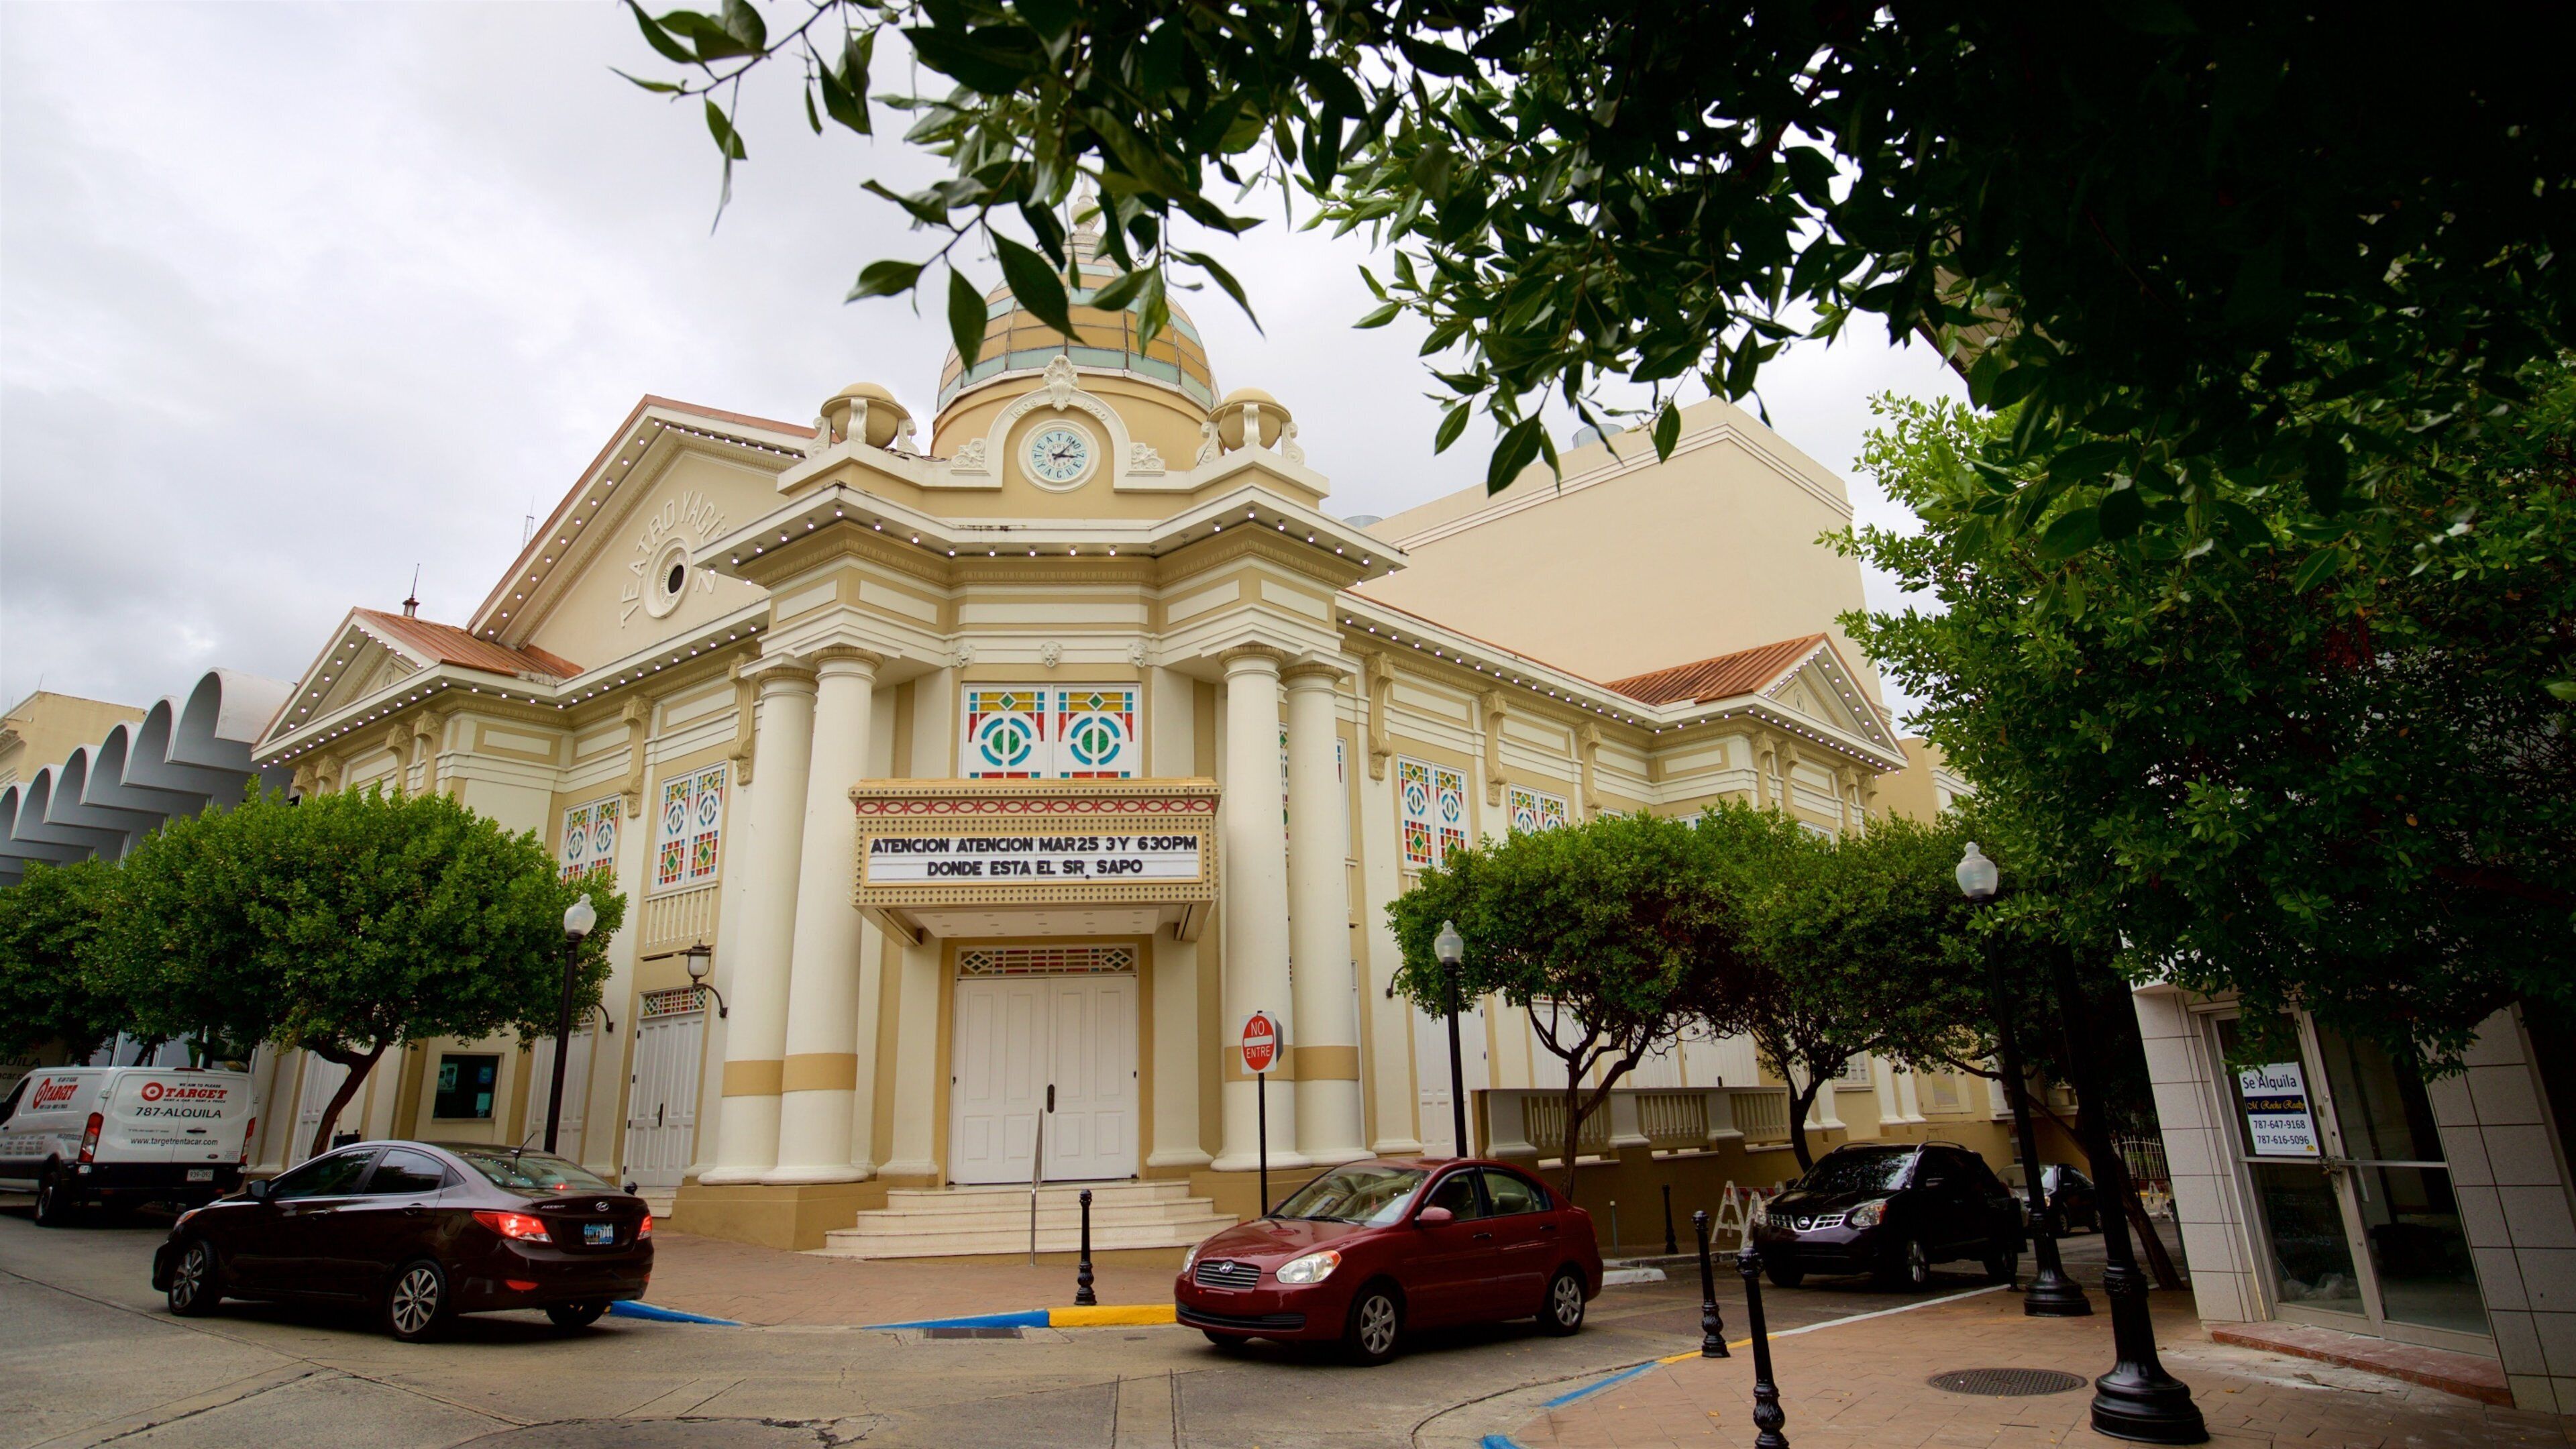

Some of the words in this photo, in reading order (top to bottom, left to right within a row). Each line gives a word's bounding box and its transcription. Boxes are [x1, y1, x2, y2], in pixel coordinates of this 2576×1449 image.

[620, 498, 676, 629] TEATRO
[871, 838, 949, 853] ATENCION
[956, 837, 1033, 853] ATENCION
[927, 861, 983, 875] DONDE
[990, 861, 1032, 875] ESTA
[1036, 860, 1056, 875] EL
[1097, 859, 1143, 873] SAPO
[1250, 1020, 1265, 1036] NO
[1246, 1046, 1271, 1059] ENTRE
[2243, 1077, 2255, 1088] Se
[2259, 1074, 2297, 1091] Alquila
[43, 1085, 78, 1101] TARGET
[166, 1088, 228, 1099] TARGET
[136, 1107, 221, 1118] 787-ALQUILA
[2254, 1120, 2306, 1129] 787-647-9168
[131, 1138, 218, 1146] www.targetrentacar.com
[2257, 1134, 2310, 1144] 787-616-5096
